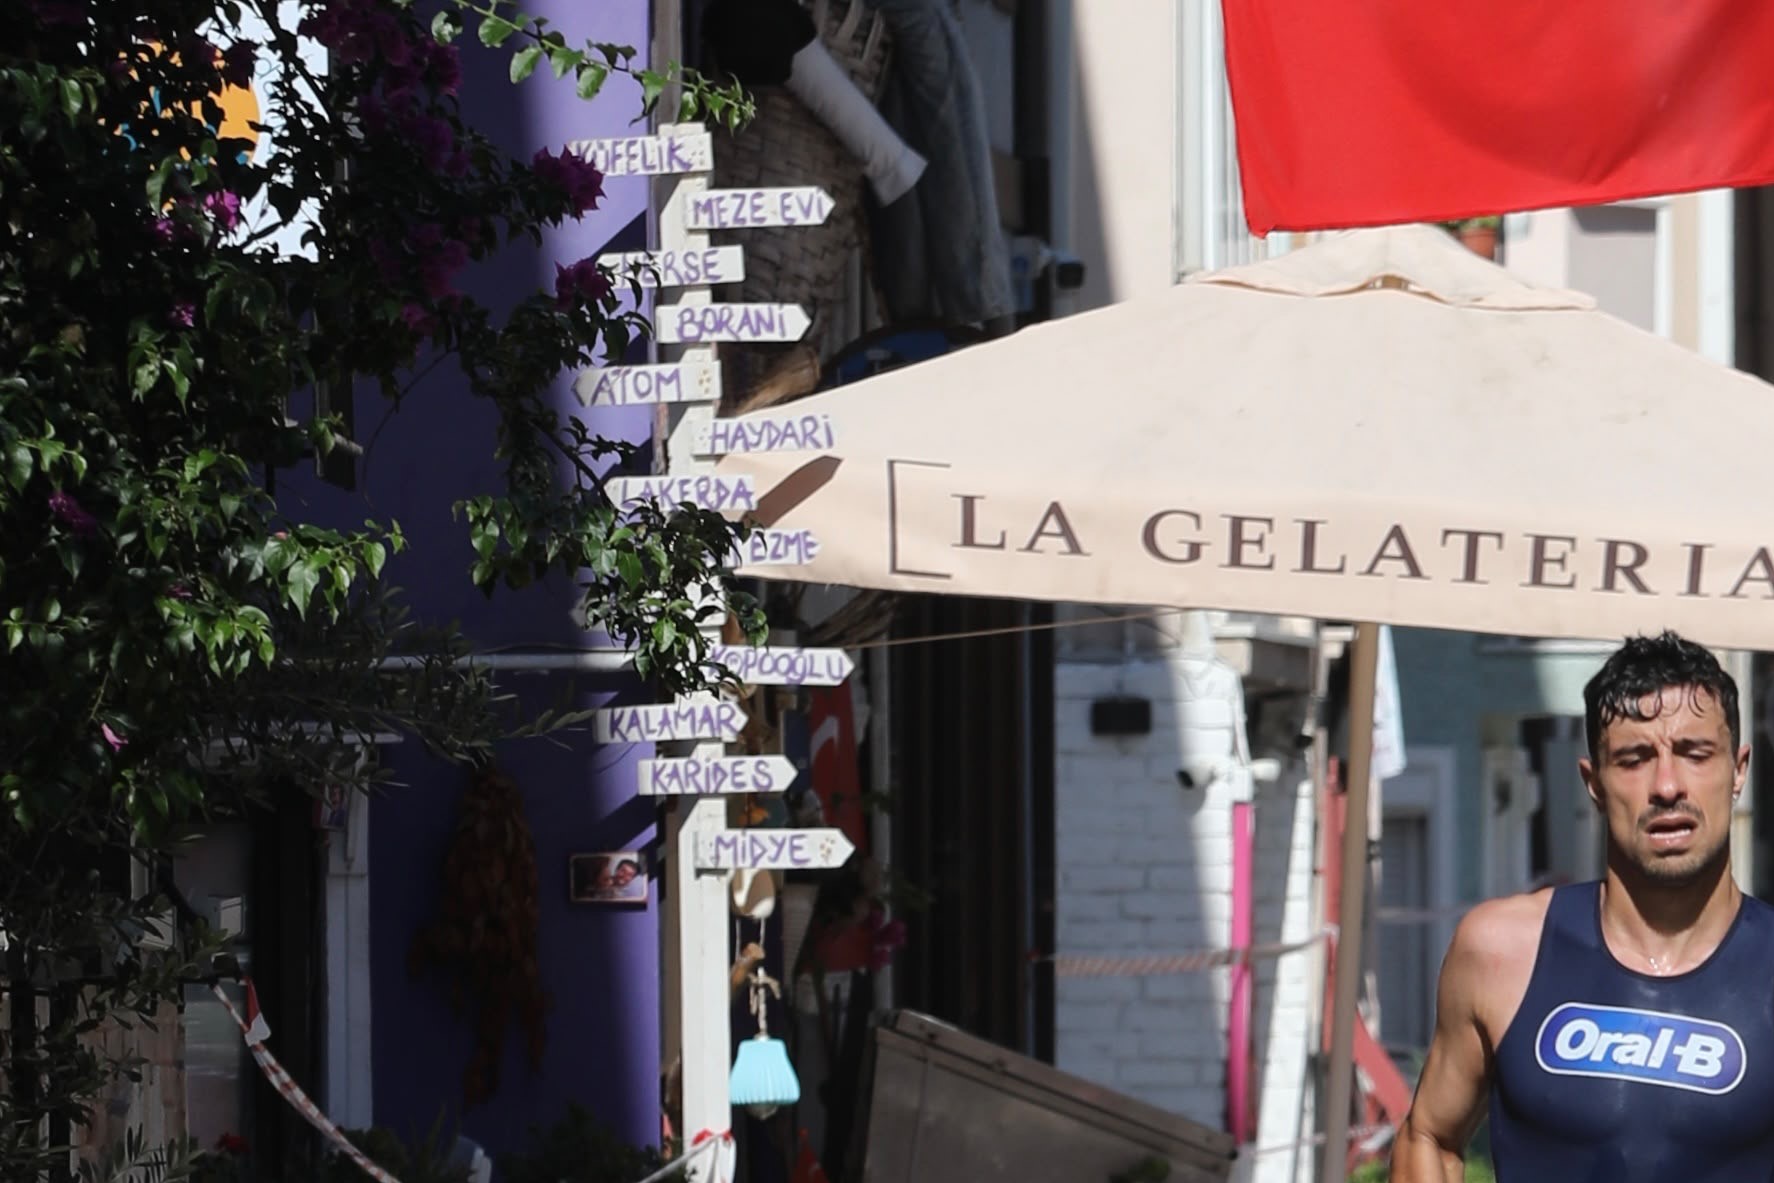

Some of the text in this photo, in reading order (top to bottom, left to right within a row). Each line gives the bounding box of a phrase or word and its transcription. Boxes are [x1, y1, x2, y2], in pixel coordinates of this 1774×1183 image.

[692, 188, 824, 229] MEZE EVİ
[675, 304, 787, 339] BORANİ
[591, 364, 682, 402] ATOM
[708, 414, 833, 451] HAYDARİ
[621, 475, 754, 513] LAKERDA
[951, 492, 1092, 558] LA
[609, 702, 741, 742] KALAMAR
[650, 757, 774, 797] KARİDES
[713, 827, 812, 868] MİDYE
[1555, 1018, 1725, 1077] Oral-B
